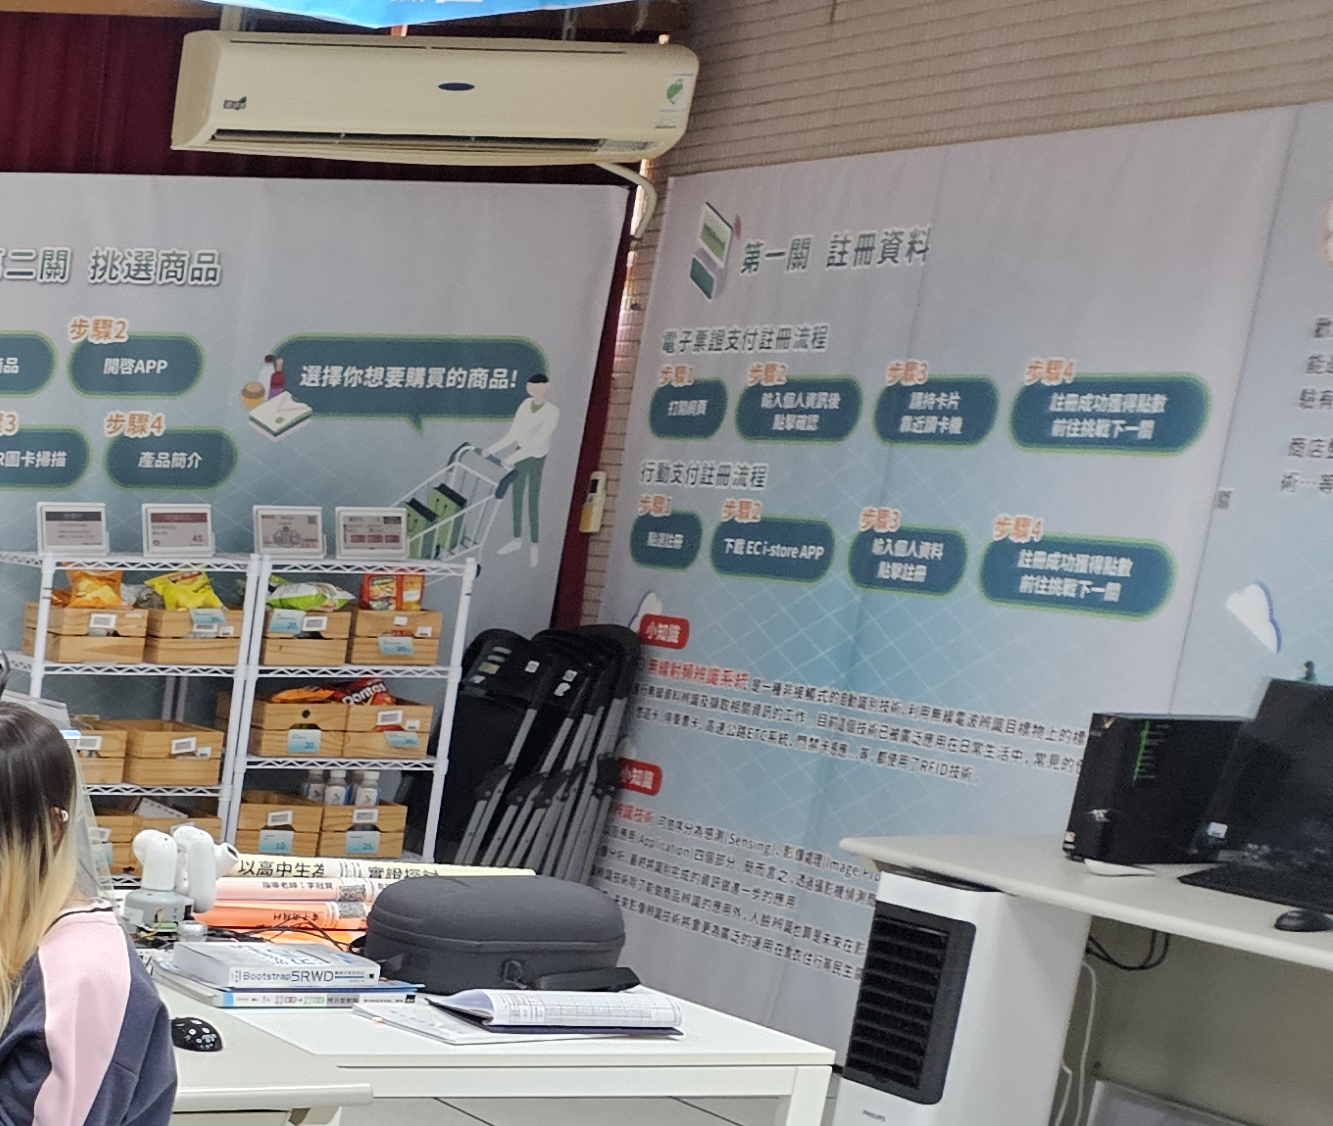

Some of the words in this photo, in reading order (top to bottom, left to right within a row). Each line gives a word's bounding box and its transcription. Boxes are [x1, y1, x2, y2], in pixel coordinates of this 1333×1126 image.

[740, 236, 813, 274] 第一關
[825, 225, 931, 270] 註冊資料
[89, 249, 222, 285] 挑選商品
[70, 319, 128, 342] 步驟2
[662, 324, 829, 354] 電子票證支付註冊流程
[748, 363, 787, 385] 步驟2
[887, 360, 929, 385] 步驟3
[1025, 358, 1075, 385] 步驟4
[105, 414, 164, 437] 步驟4
[138, 451, 203, 469] 產品簡介
[639, 458, 769, 490] 行動支付註冊流程
[721, 498, 763, 523] 步驟2
[859, 506, 901, 532] 步驟3
[992, 514, 1044, 542] 步驟4
[799, 544, 826, 561] APP
[342, 681, 388, 706] Doritos
